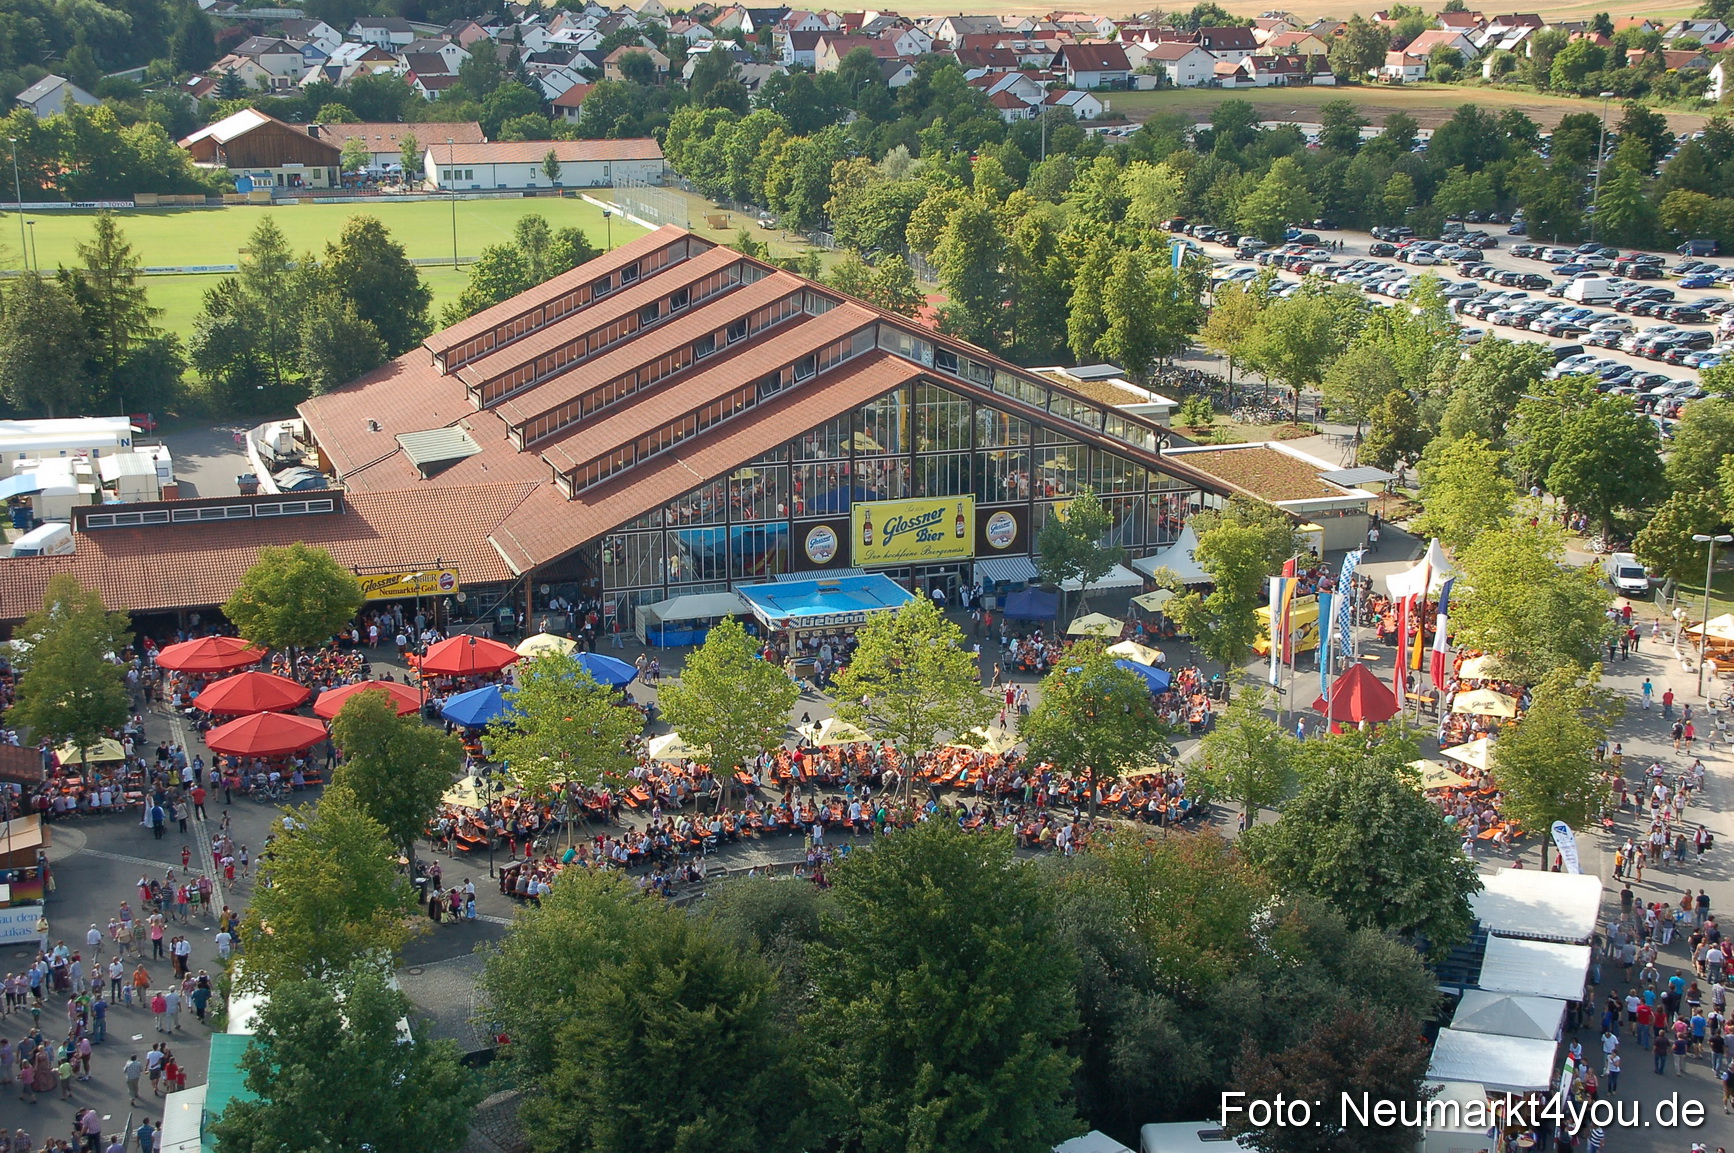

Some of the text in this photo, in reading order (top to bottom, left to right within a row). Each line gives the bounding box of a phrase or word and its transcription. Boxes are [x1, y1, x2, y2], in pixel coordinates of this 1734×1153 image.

[882, 507, 946, 546] Glossner
[915, 527, 945, 543] Bier
[864, 545, 964, 561] Der hochfeine Biergenuss
[361, 574, 402, 594] Glossner
[421, 584, 438, 592] Gold
[16, 913, 38, 923] den
